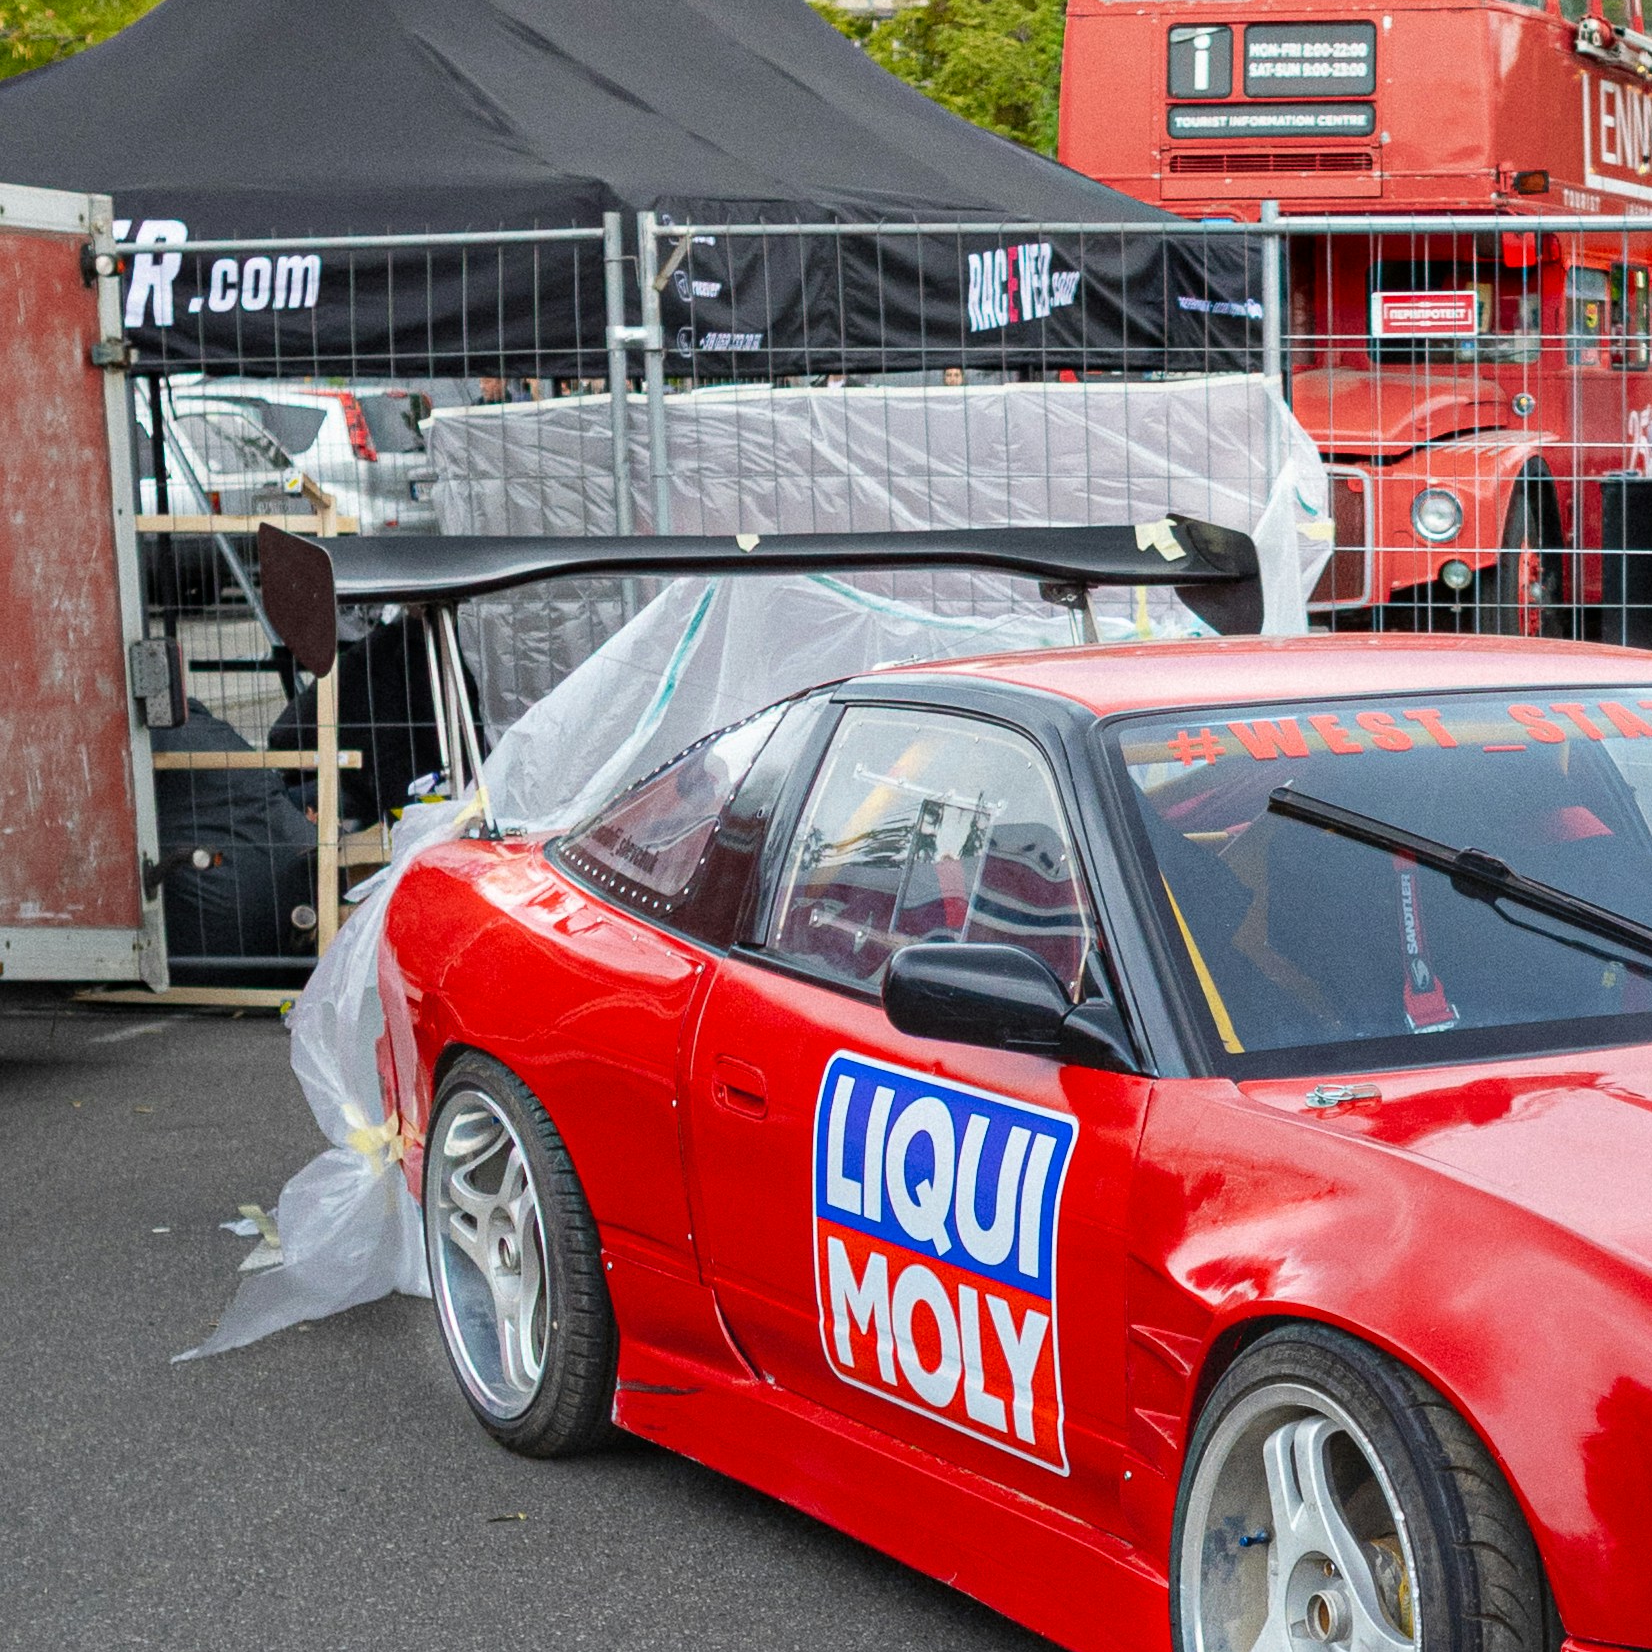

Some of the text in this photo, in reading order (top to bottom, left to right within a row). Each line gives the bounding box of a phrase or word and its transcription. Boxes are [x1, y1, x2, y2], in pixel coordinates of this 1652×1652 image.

[1249, 42, 1301, 58] MON-FRI
[1248, 62, 1301, 77] SAT-SUN
[1175, 114, 1368, 128] TOURIST INFORMATION CENTRE
[1563, 188, 1601, 212] TOURIST
[1400, 873, 1418, 956] SANDTLER
[825, 1073, 1058, 1279] LIQUI
[828, 1236, 1053, 1446] MOLY
